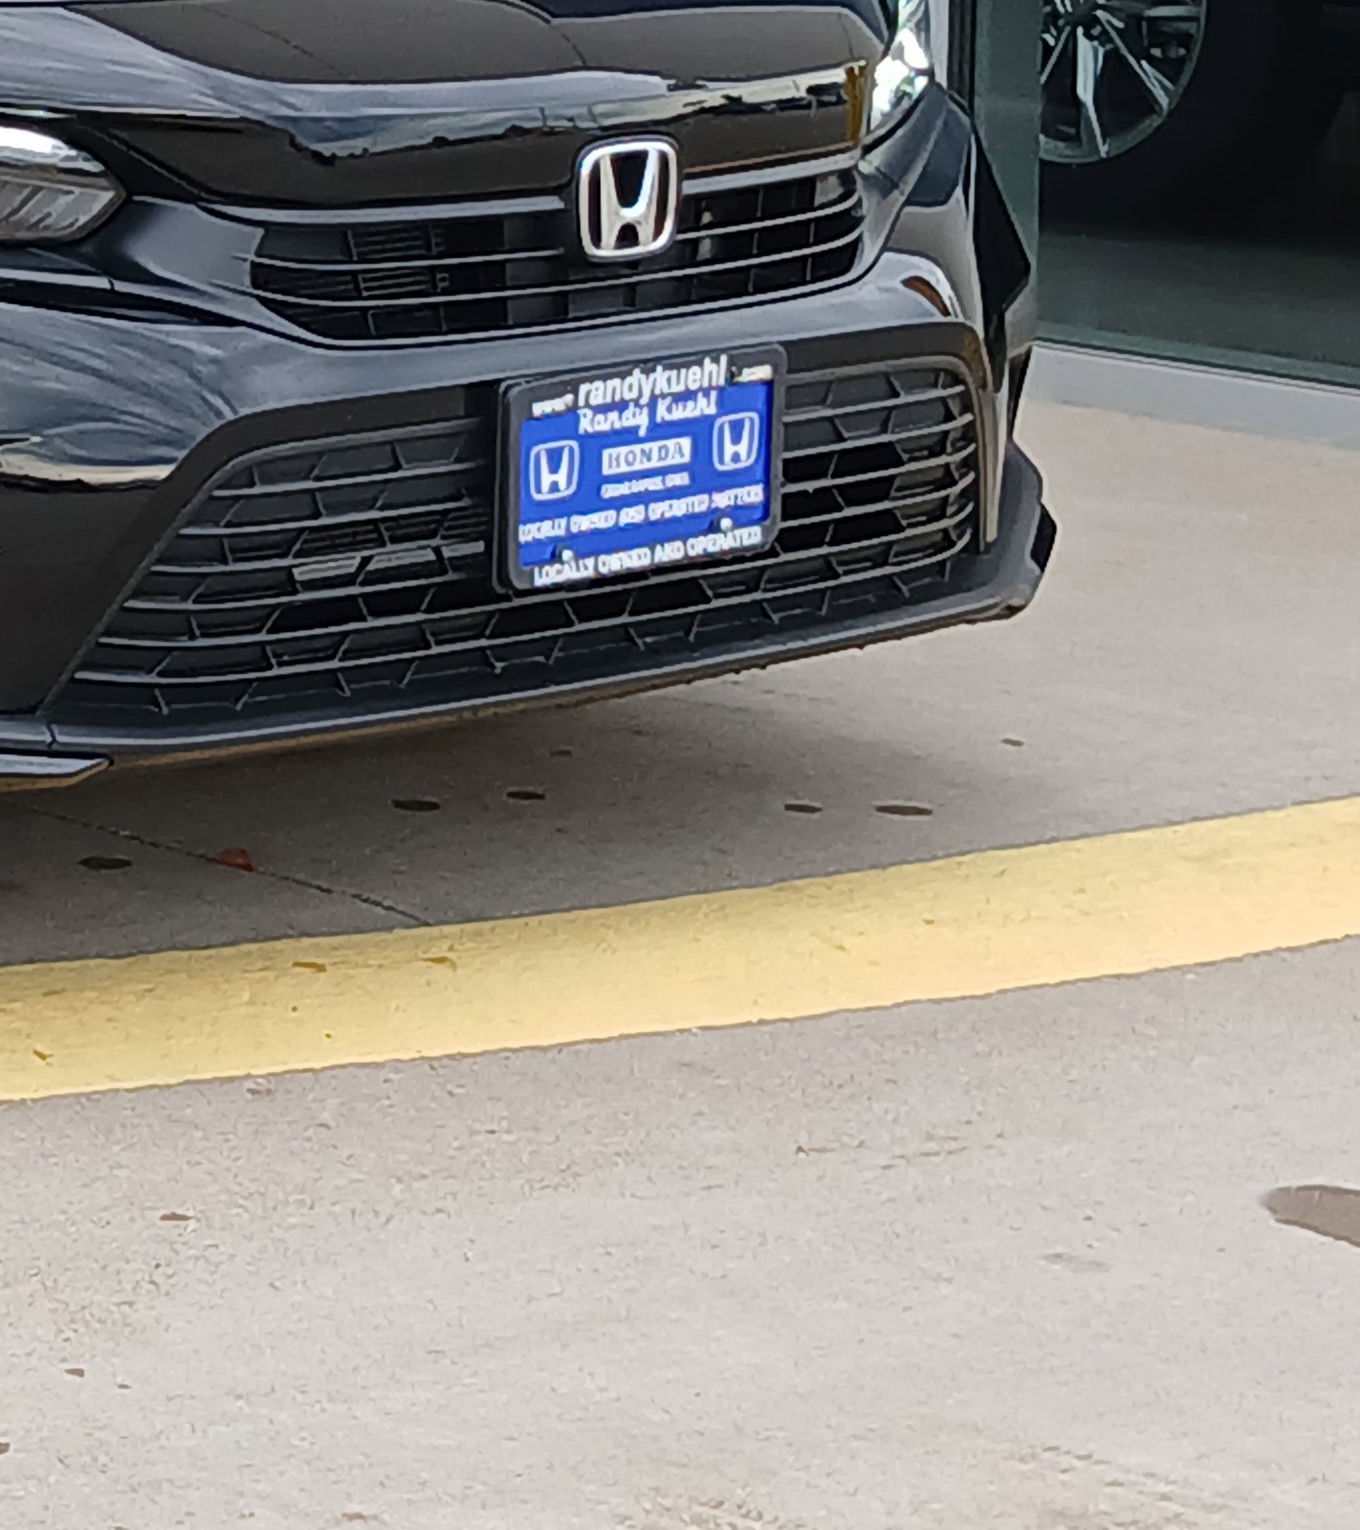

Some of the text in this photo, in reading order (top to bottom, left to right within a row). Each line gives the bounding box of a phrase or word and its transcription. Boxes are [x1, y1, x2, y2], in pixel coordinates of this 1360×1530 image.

[578, 354, 728, 407] randykuehl
[577, 390, 718, 438] Randy Kuehl
[606, 441, 686, 470] HONDA
[533, 525, 762, 588] LOCALLY OWNED AND OPERATED
